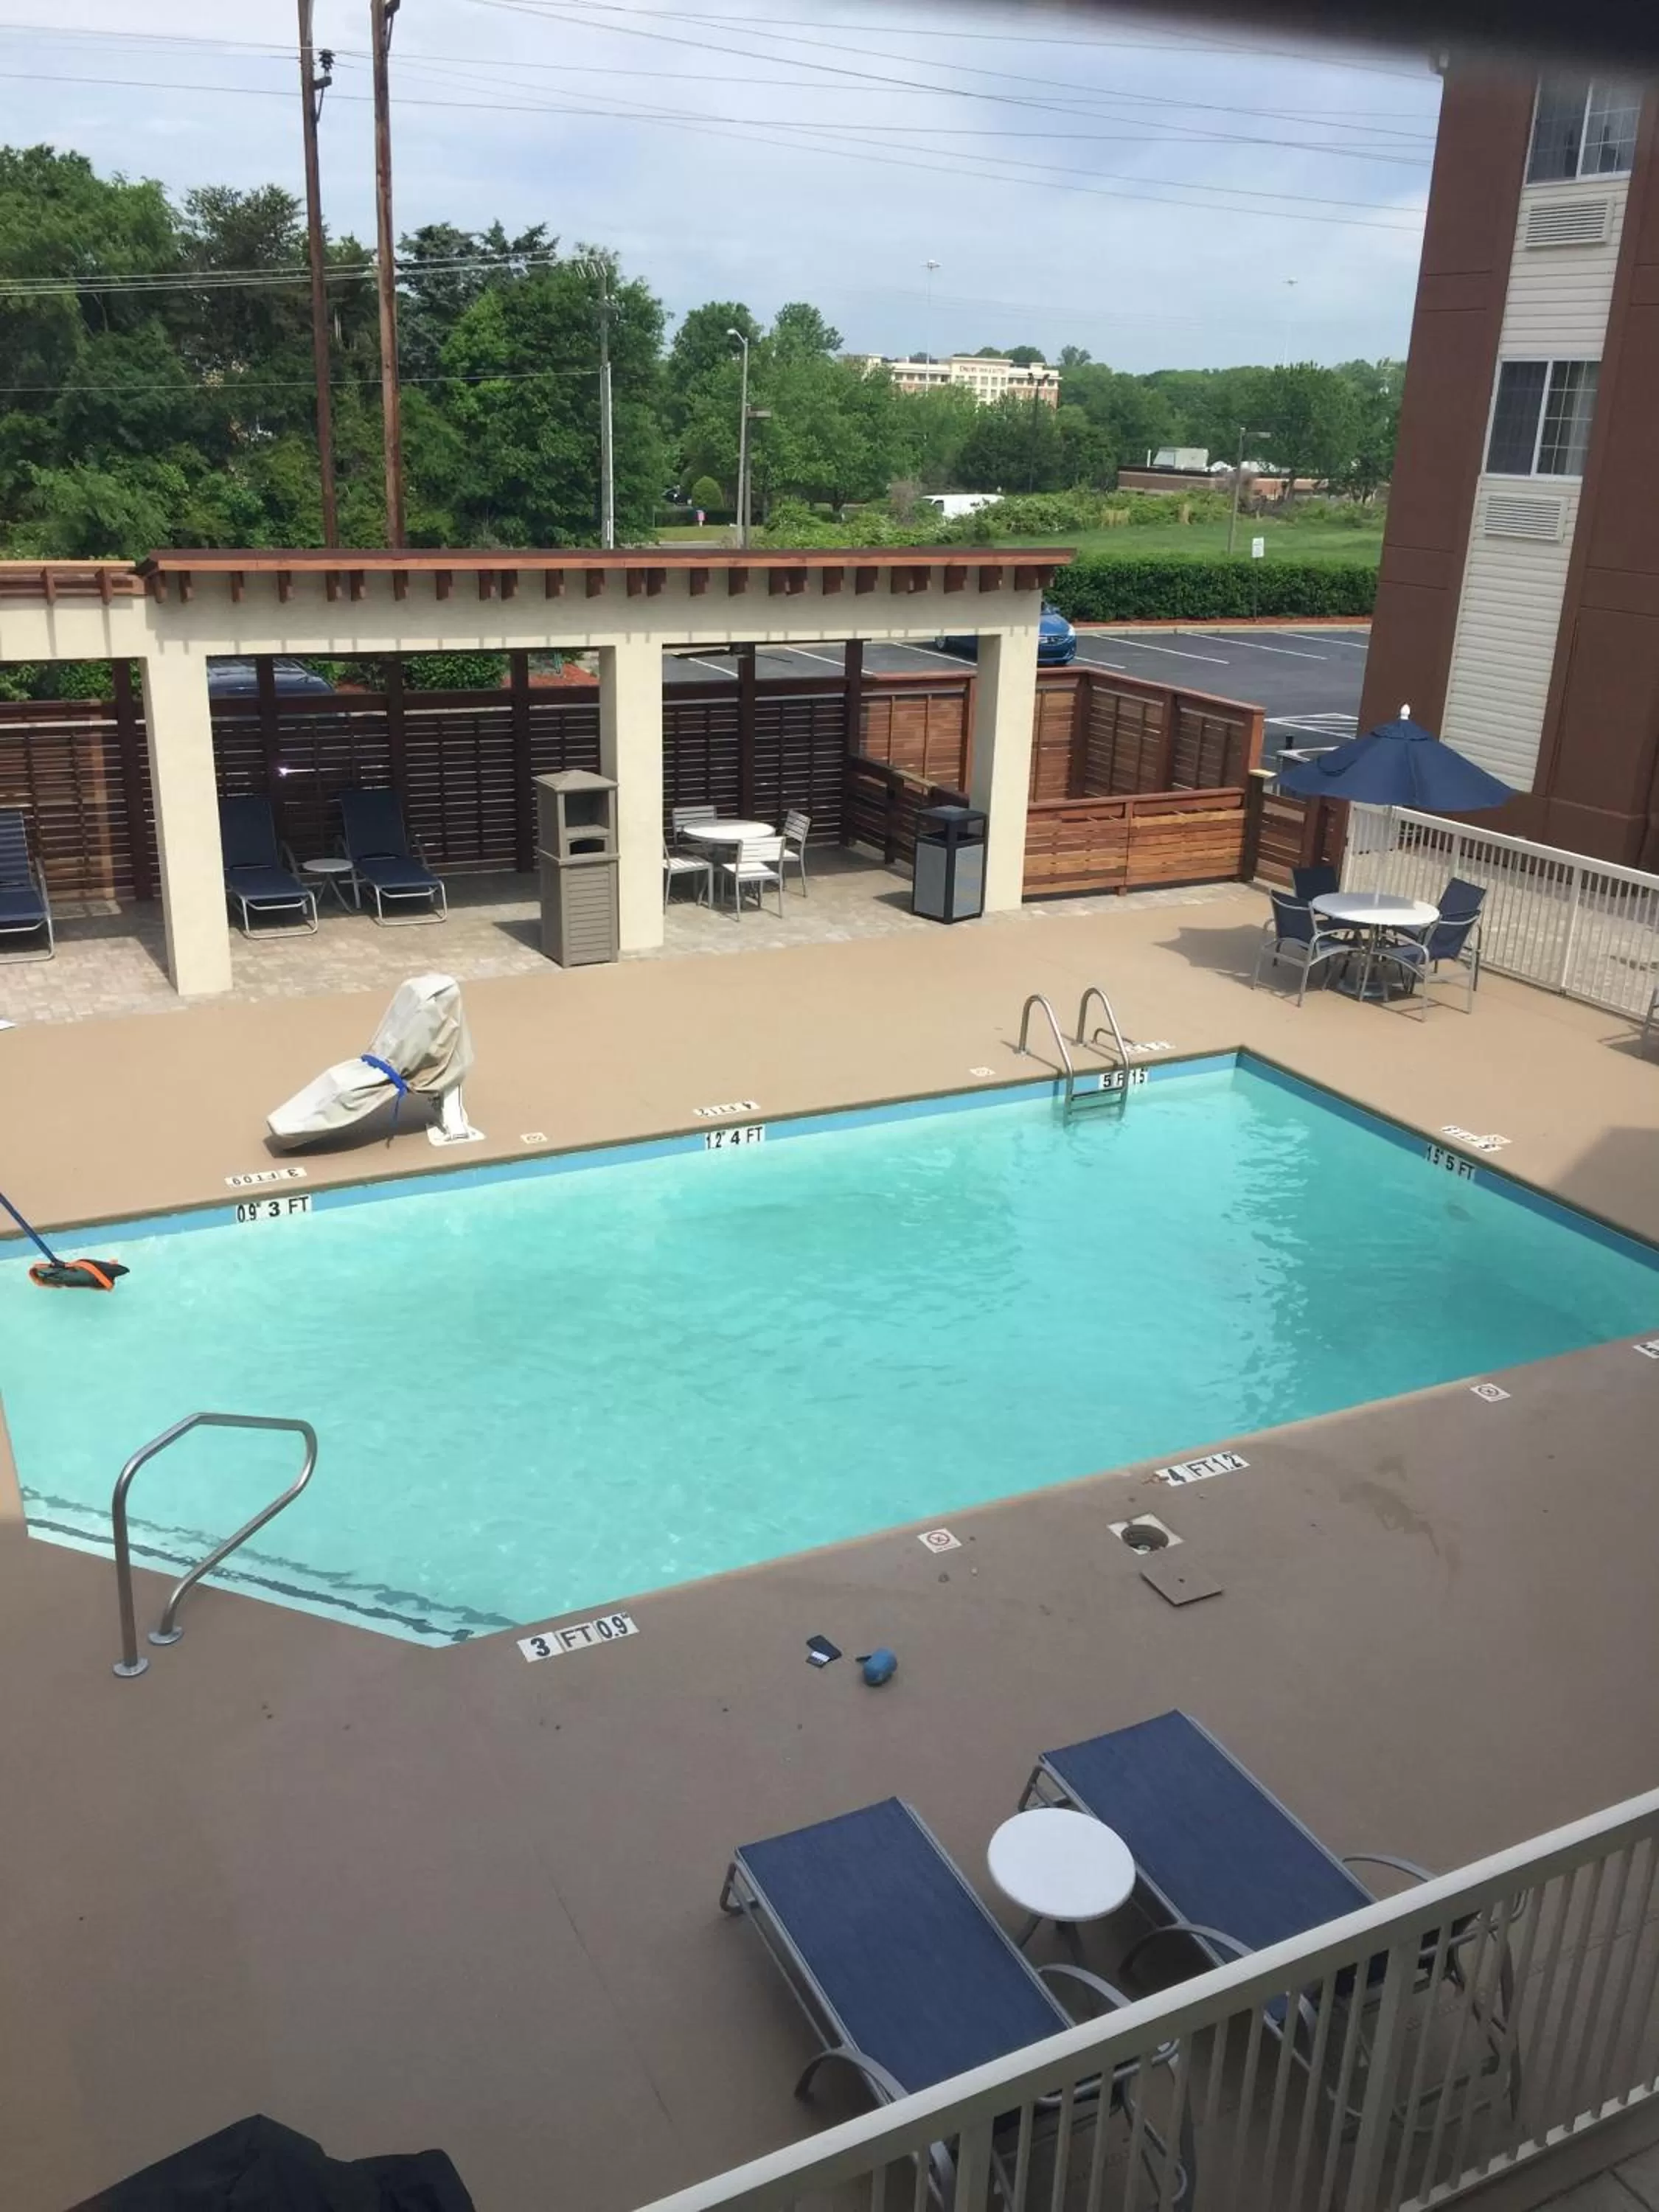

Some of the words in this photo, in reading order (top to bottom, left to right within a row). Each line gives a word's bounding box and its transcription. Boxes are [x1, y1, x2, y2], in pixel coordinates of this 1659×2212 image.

[1103, 1074, 1112, 1088] 5
[730, 1130, 741, 1145] 4
[746, 1126, 764, 1144] FT
[1445, 1154, 1455, 1171] 5
[1457, 1161, 1475, 1180] FT
[268, 1200, 282, 1217] 3
[288, 1195, 309, 1214] FT
[1186, 1460, 1217, 1478] FT
[530, 1637, 552, 1658] 3
[560, 1624, 594, 1649] FT
